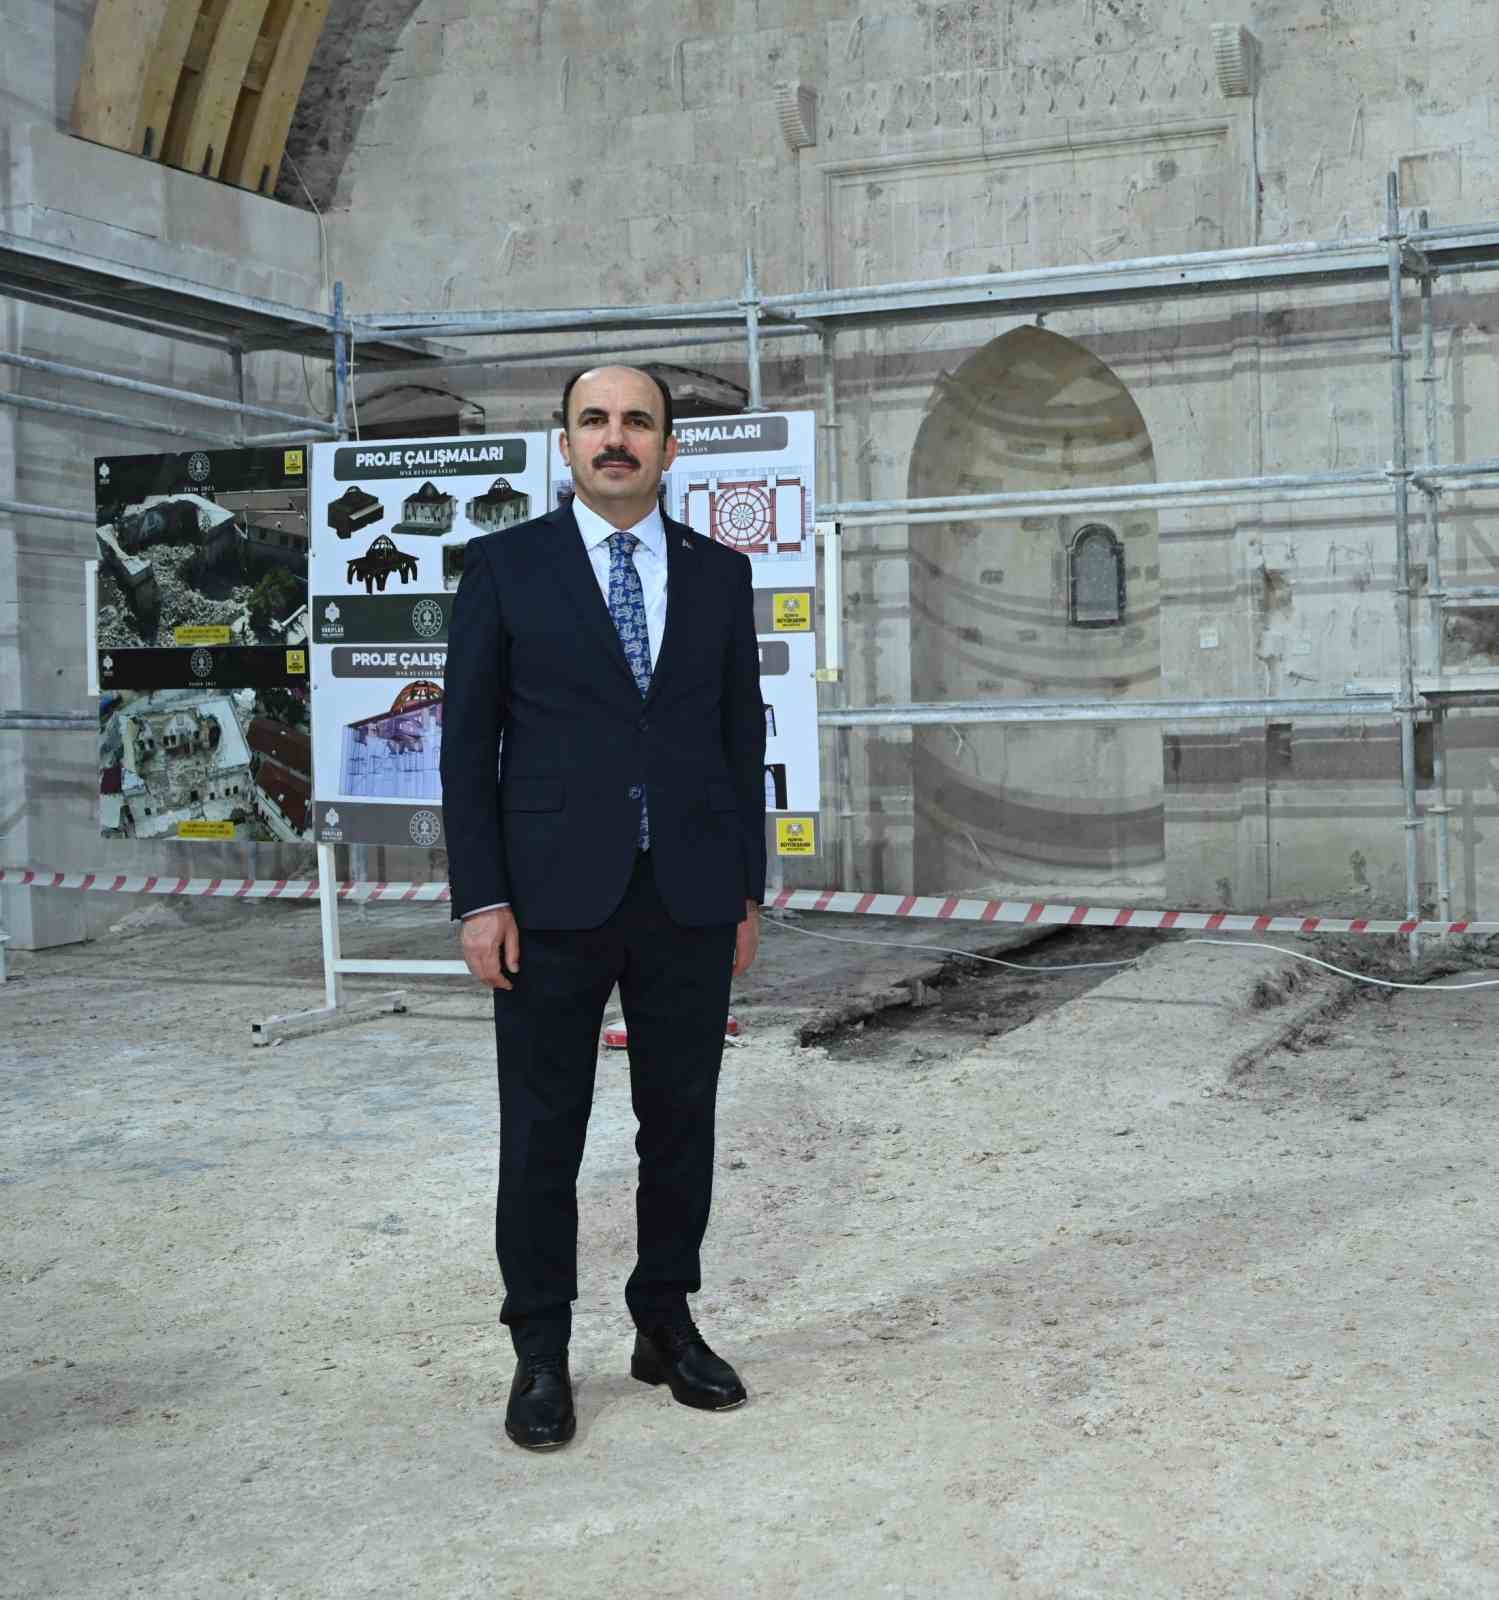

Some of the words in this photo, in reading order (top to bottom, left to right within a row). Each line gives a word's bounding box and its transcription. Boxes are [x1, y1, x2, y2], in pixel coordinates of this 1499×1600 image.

[355, 451, 402, 467] PROJE
[404, 446, 504, 469] ÇALIŞMALARI
[351, 652, 398, 666] PROJE
